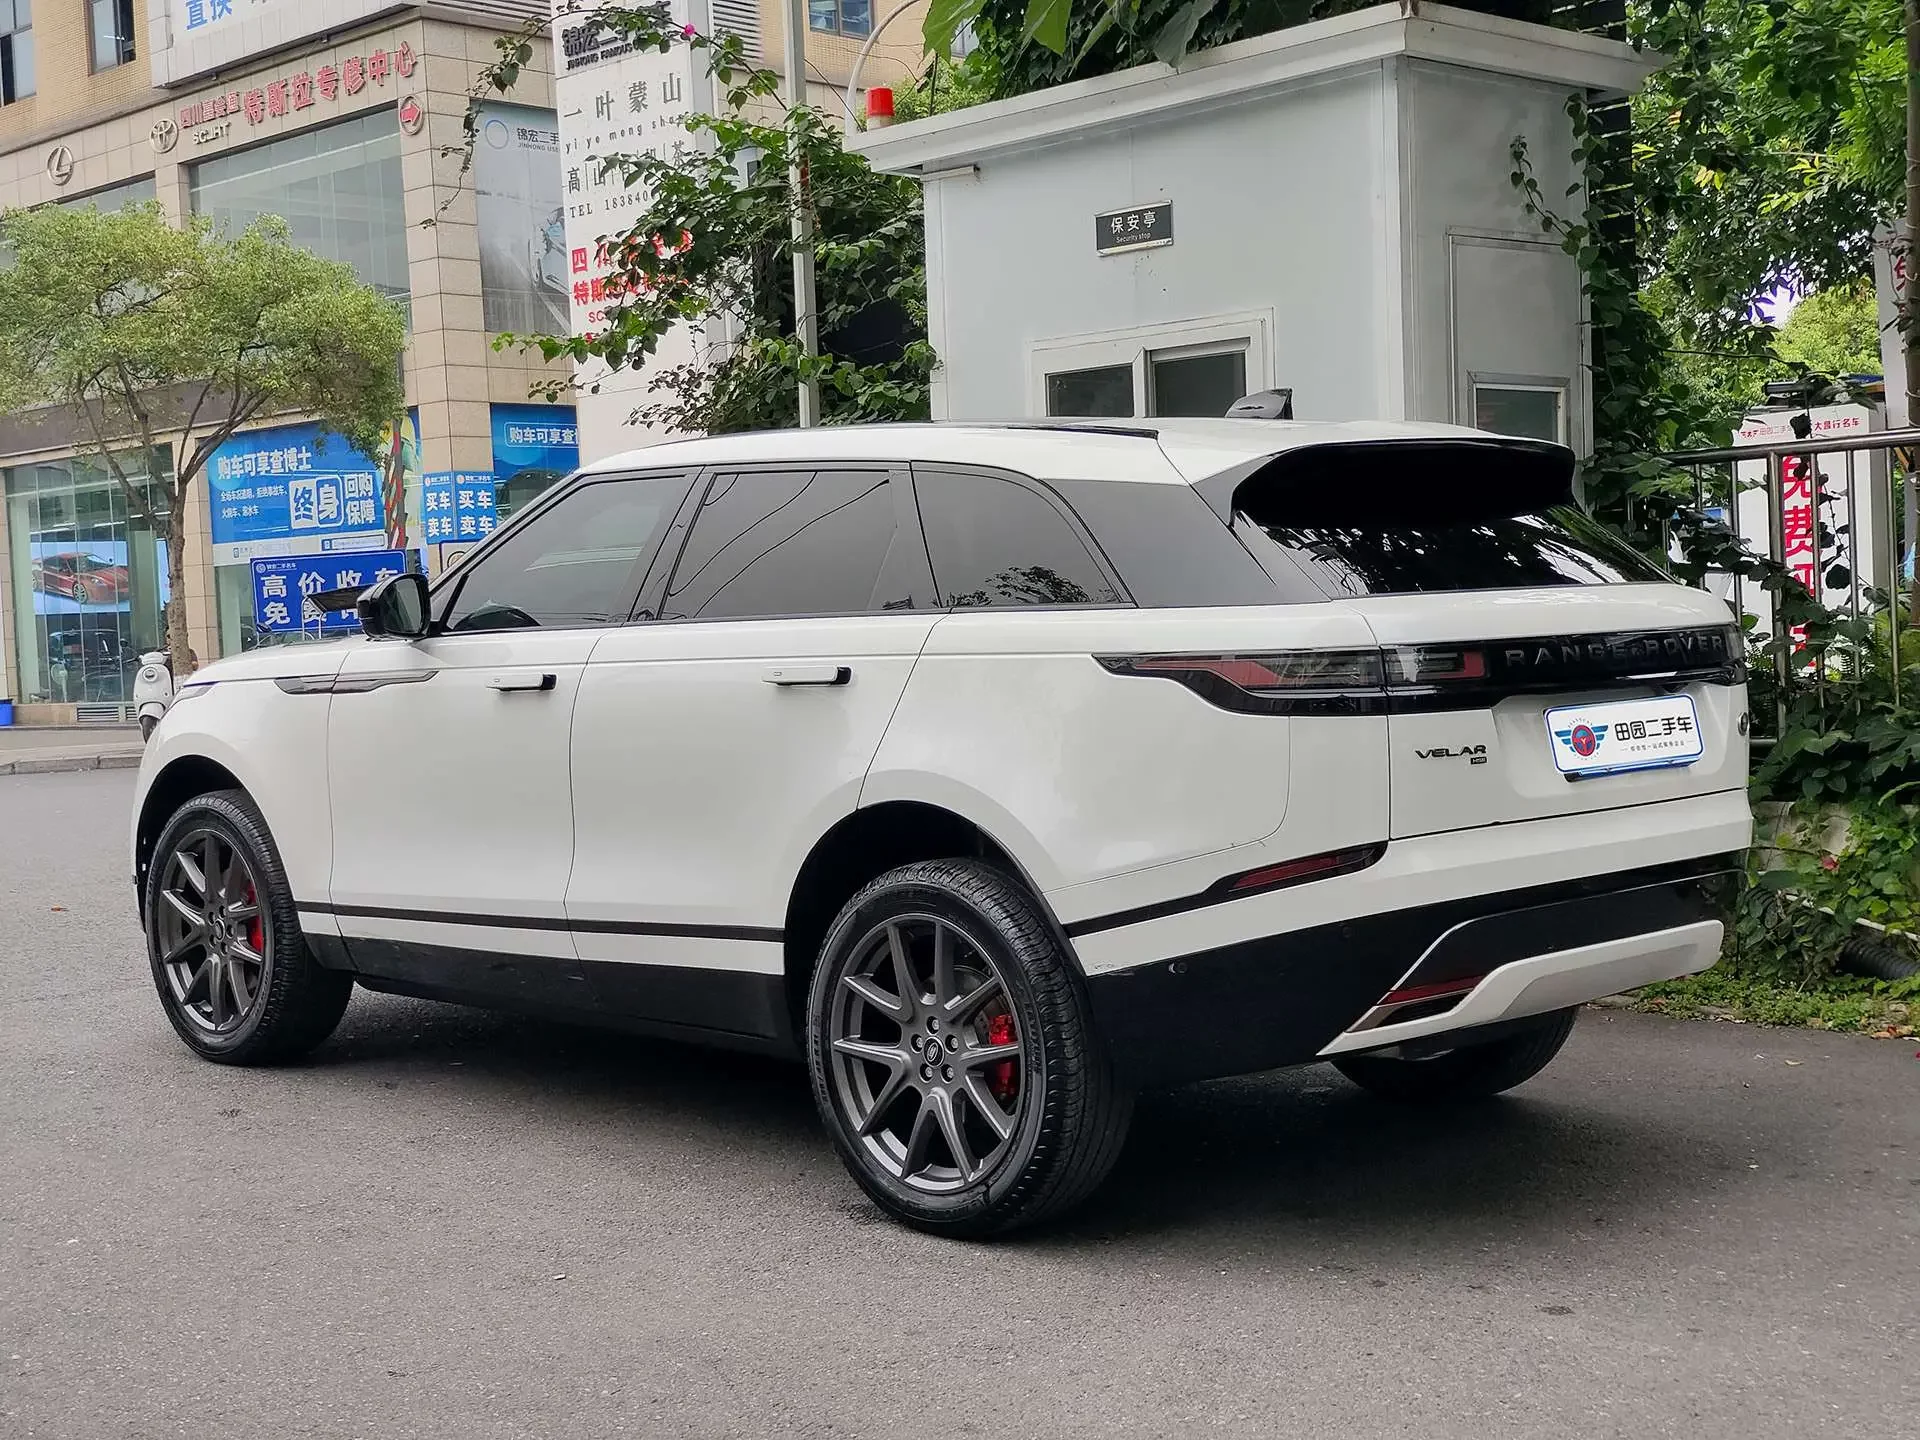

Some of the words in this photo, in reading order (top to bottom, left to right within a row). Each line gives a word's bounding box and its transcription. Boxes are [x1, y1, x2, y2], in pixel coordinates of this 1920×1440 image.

[243, 41, 417, 126] 特斯拉专修中心
[563, 72, 681, 121] 一叶蒙山
[609, 124, 643, 142] meng
[570, 202, 593, 218] TEL
[1111, 210, 1156, 234] 保安亭
[509, 426, 578, 444] 购车可享查
[217, 446, 312, 480] 购车可享查博士
[344, 473, 374, 499] 回购
[294, 483, 340, 521] 终身
[426, 490, 452, 512] 买车
[458, 489, 493, 510] 买车
[346, 499, 376, 526] 保障
[427, 516, 453, 538] 卖车
[460, 515, 495, 536] 卖车
[1505, 642, 1626, 667] RANGE
[1643, 633, 1723, 656] ROVER
[1614, 716, 1693, 742] 田园二手车
[1414, 744, 1487, 759] VELAR
